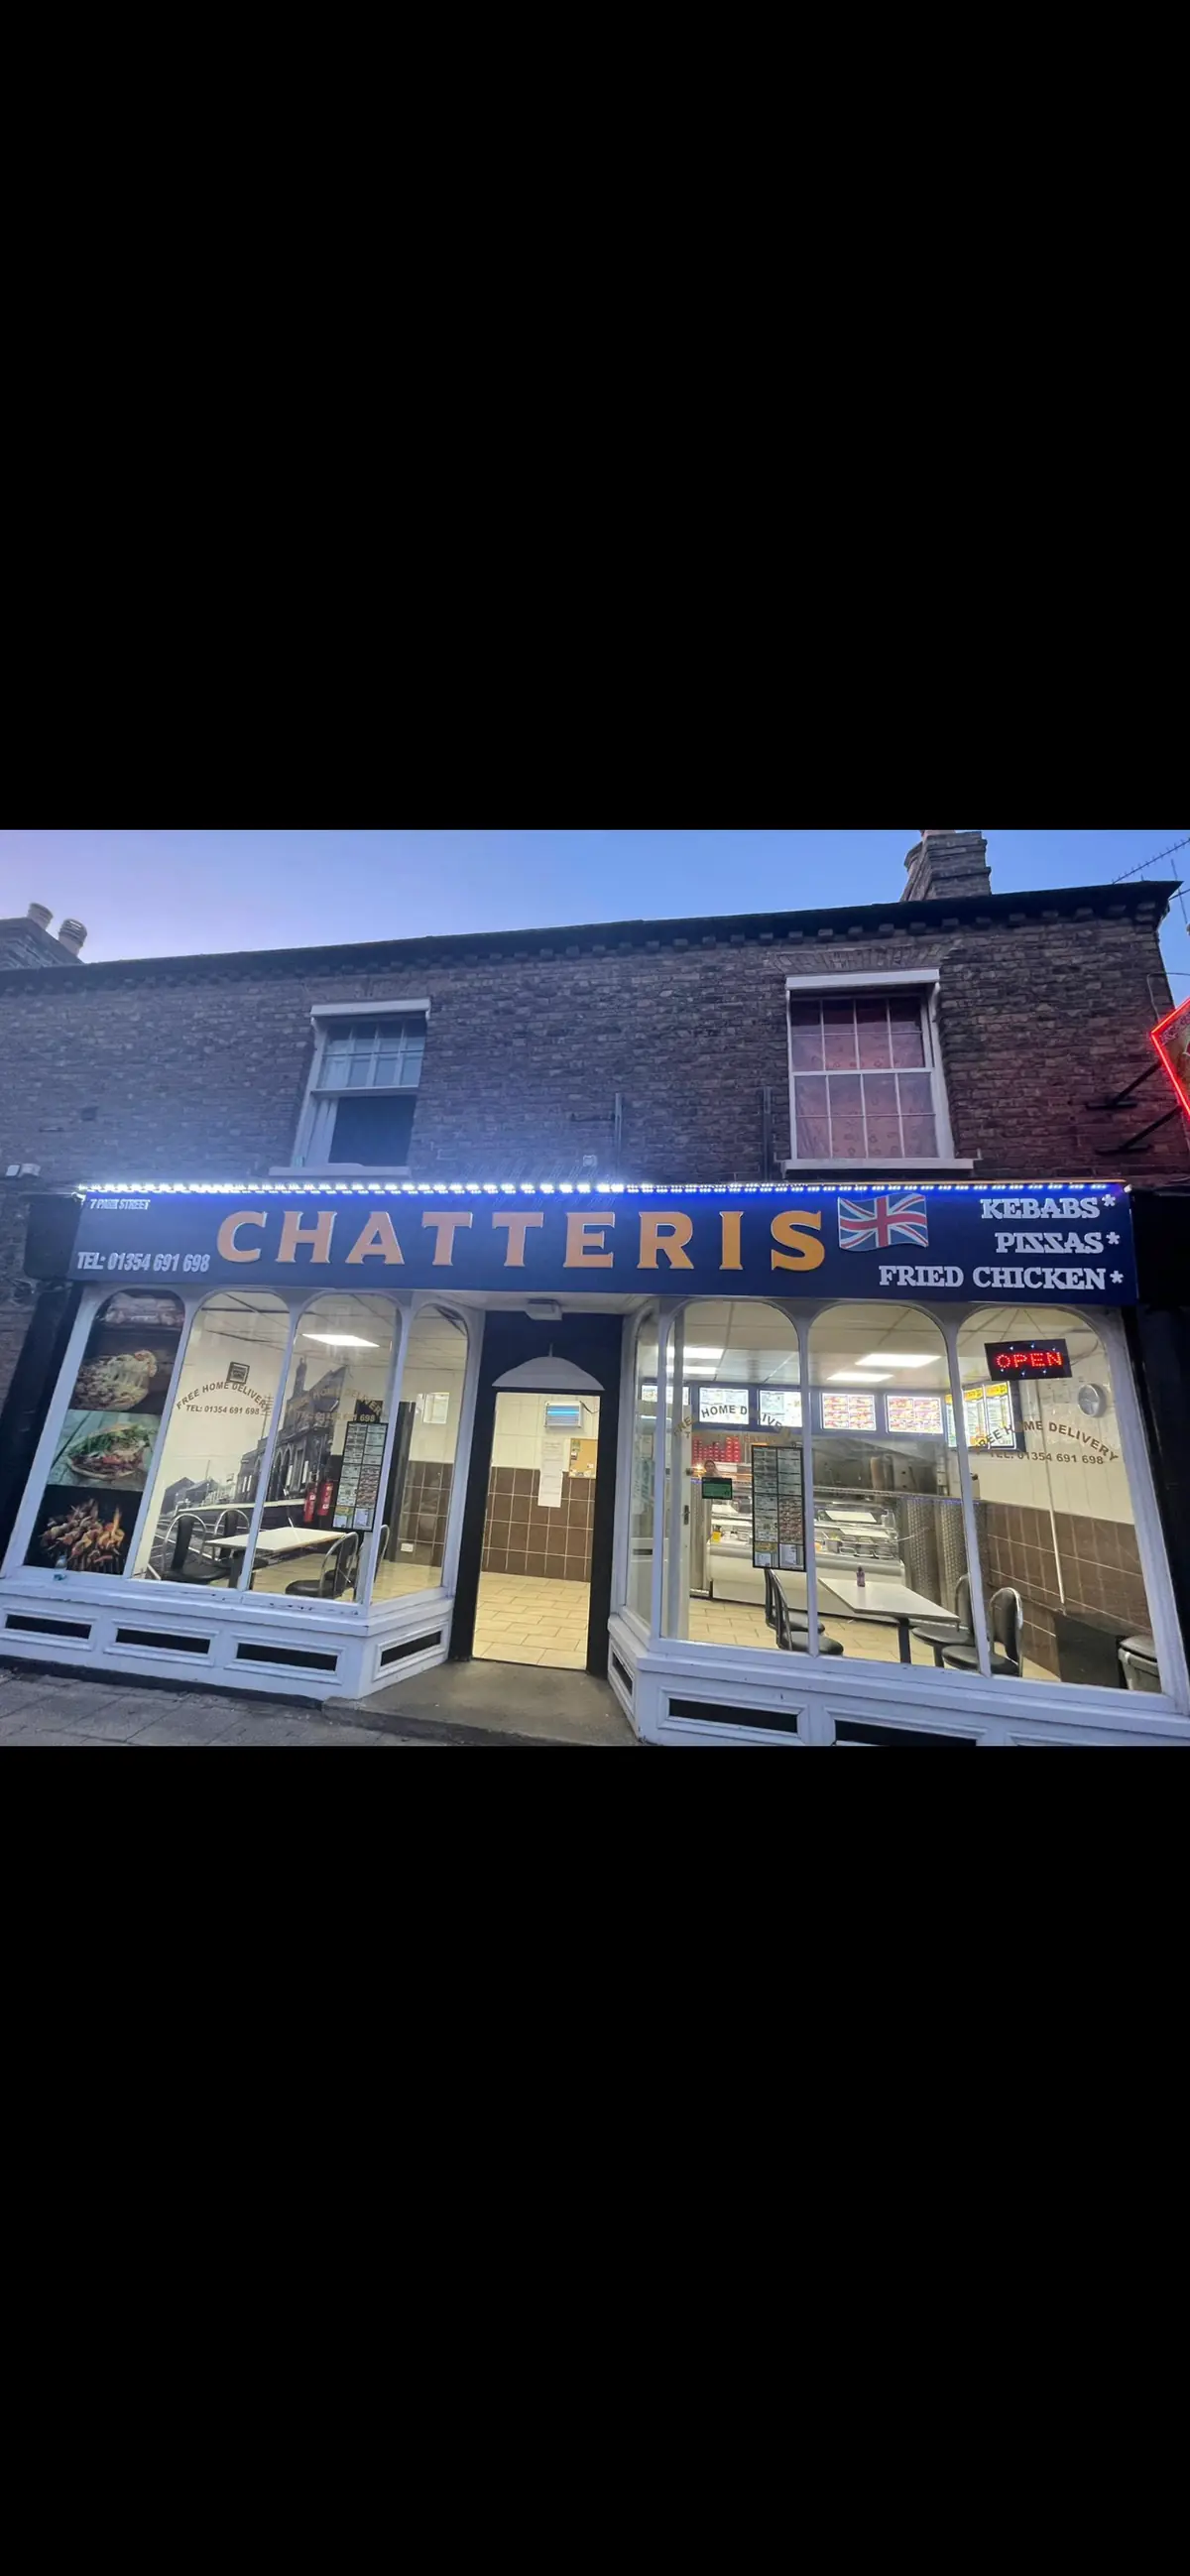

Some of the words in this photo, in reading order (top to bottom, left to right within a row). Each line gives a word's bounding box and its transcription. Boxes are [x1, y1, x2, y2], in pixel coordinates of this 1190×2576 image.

[90, 1199, 96, 1209] 7
[119, 1199, 151, 1210] STREET
[216, 1209, 826, 1272] CHATTERIS
[77, 1252, 105, 1270] TEL:
[107, 1252, 151, 1271] 01354
[153, 1253, 179, 1272] 691
[182, 1254, 210, 1273] 698
[879, 1266, 965, 1288] FRIED
[995, 1351, 1064, 1369] OPEN
[176, 1389, 200, 1410] FREE
[202, 1382, 230, 1393] HOME
[245, 1407, 260, 1415] 698
[359, 1413, 376, 1422] 698
[701, 1405, 736, 1418] HOME
[1004, 1420, 1043, 1435] HME
[1048, 1421, 1120, 1461] DELIVERY
[1017, 1452, 1053, 1462] 01354
[1056, 1454, 1078, 1463] 691
[1082, 1455, 1105, 1465] 698
